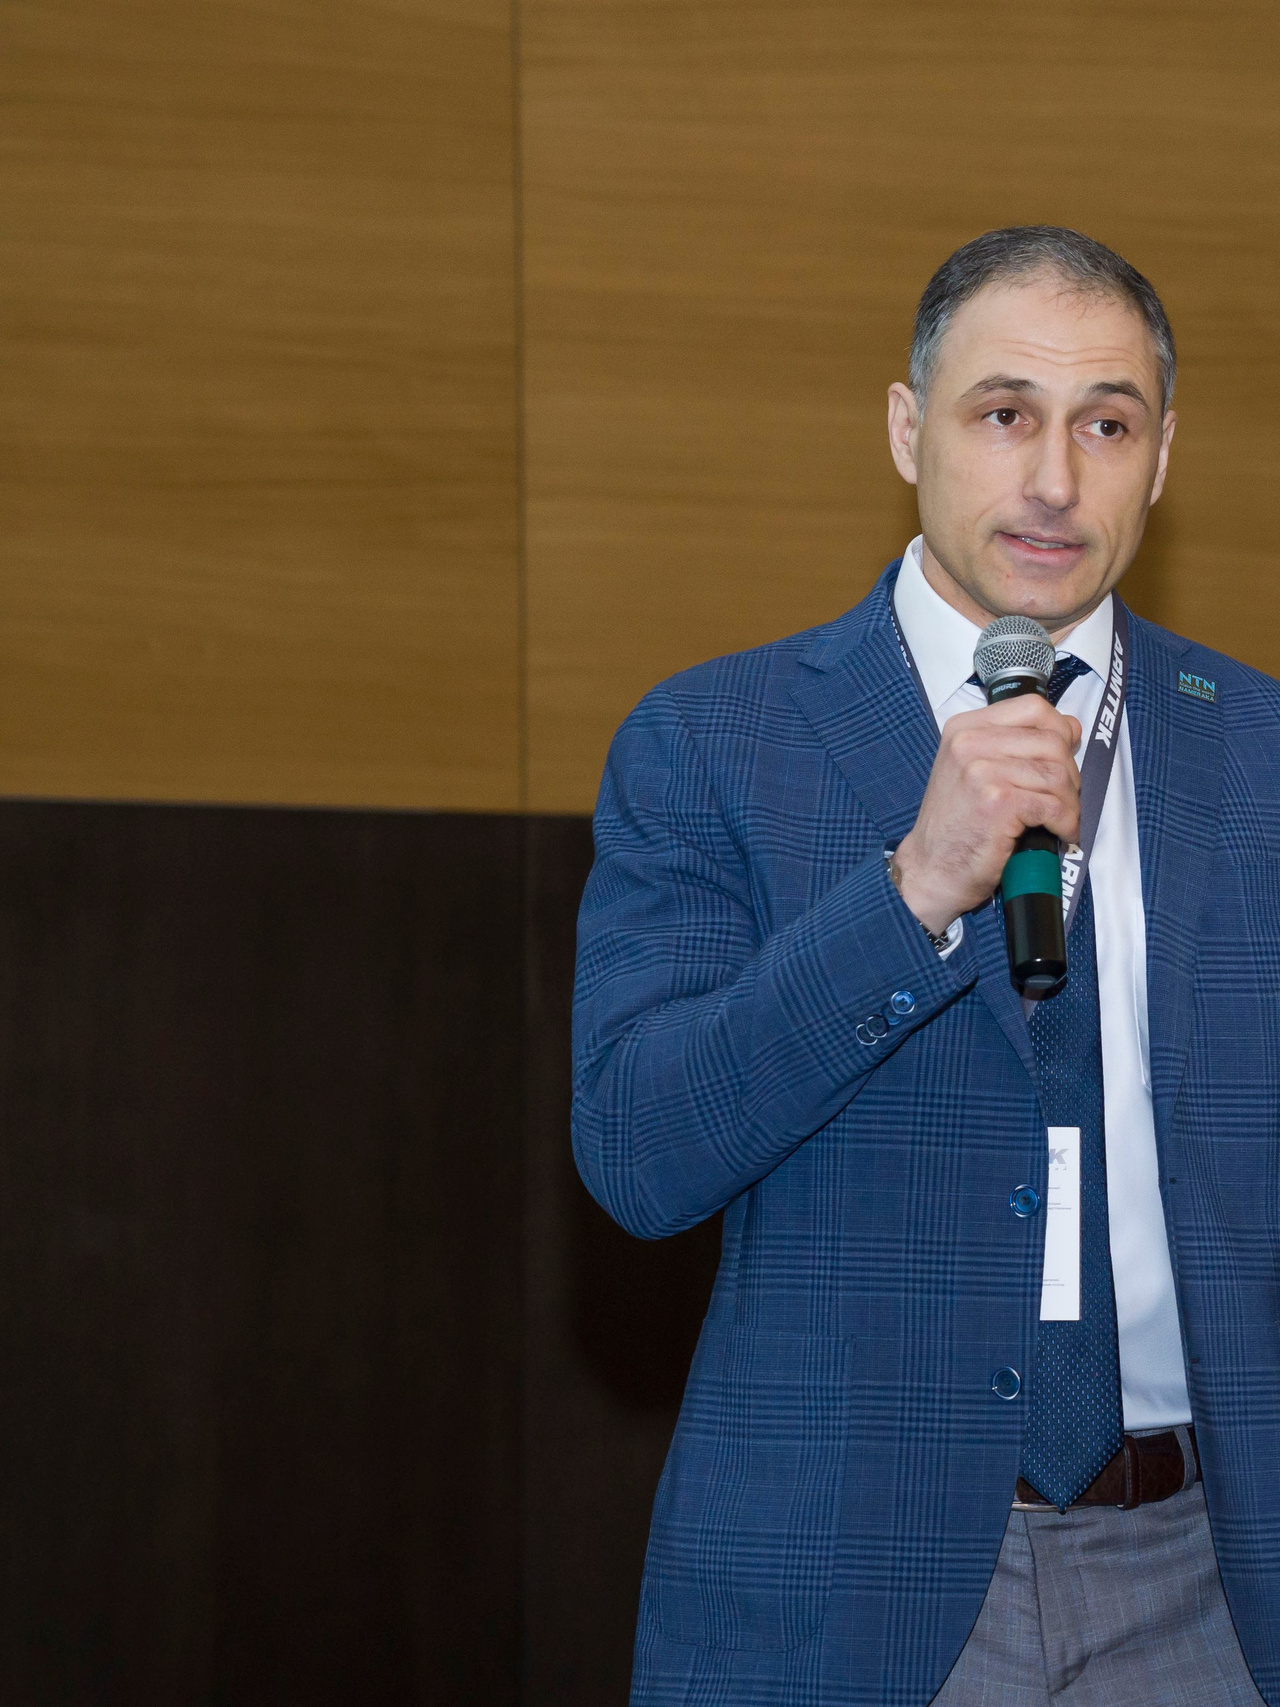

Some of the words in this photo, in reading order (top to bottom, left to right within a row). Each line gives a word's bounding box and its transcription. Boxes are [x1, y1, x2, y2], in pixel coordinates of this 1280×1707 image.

[992, 682, 1019, 695] SHURE
[1095, 631, 1123, 749] ARMTEK
[1180, 671, 1215, 693] NTN
[1061, 843, 1084, 922] ARM
